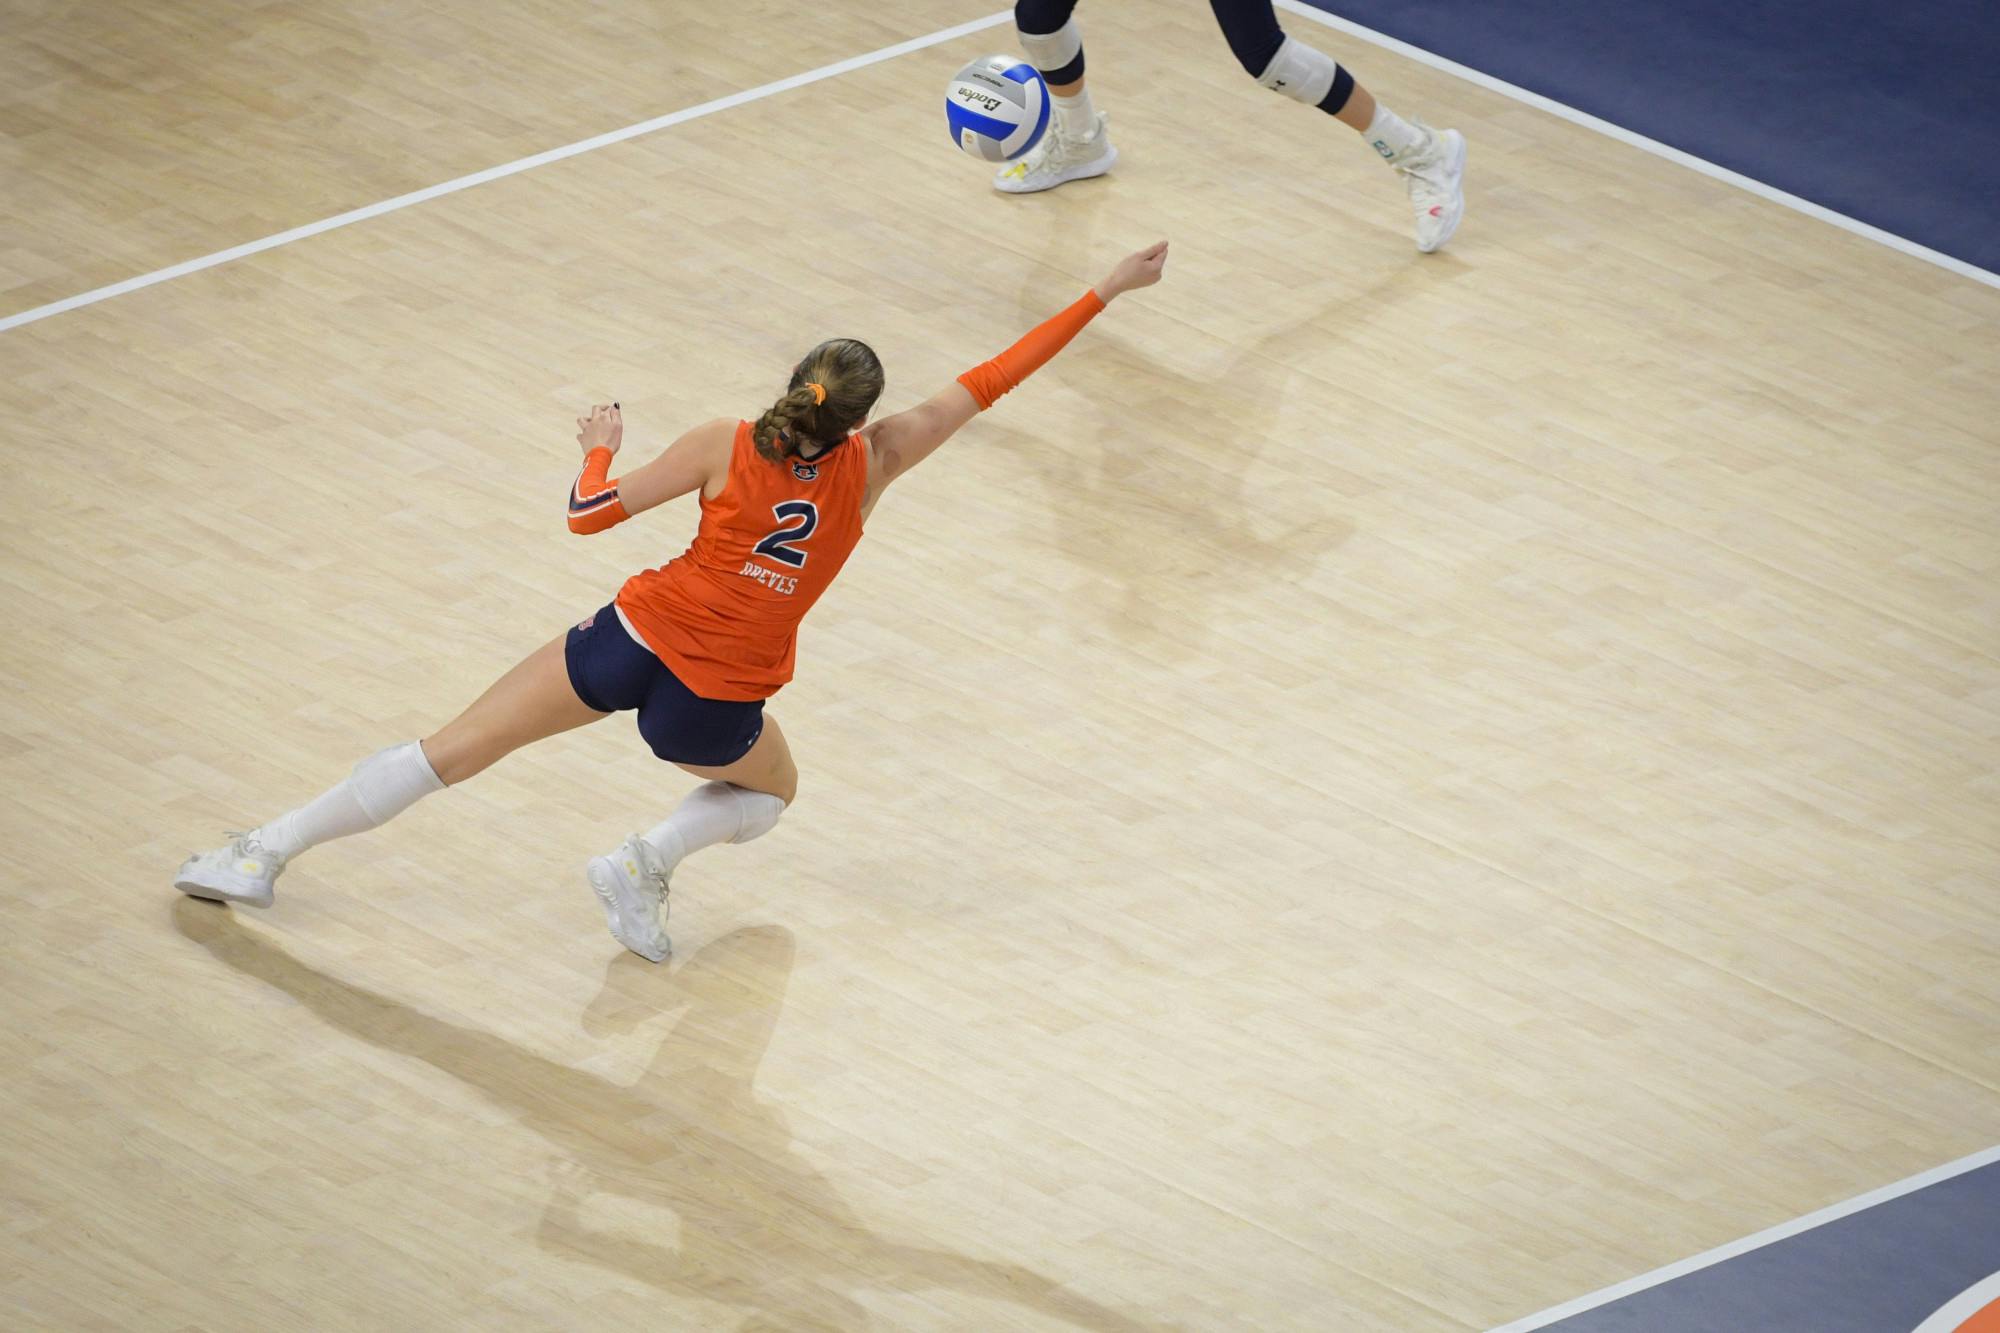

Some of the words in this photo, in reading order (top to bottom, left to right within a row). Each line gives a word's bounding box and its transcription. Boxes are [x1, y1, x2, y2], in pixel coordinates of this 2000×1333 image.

[958, 87, 1002, 111] Baden
[752, 500, 819, 568] 2
[739, 561, 798, 595] DREVES
